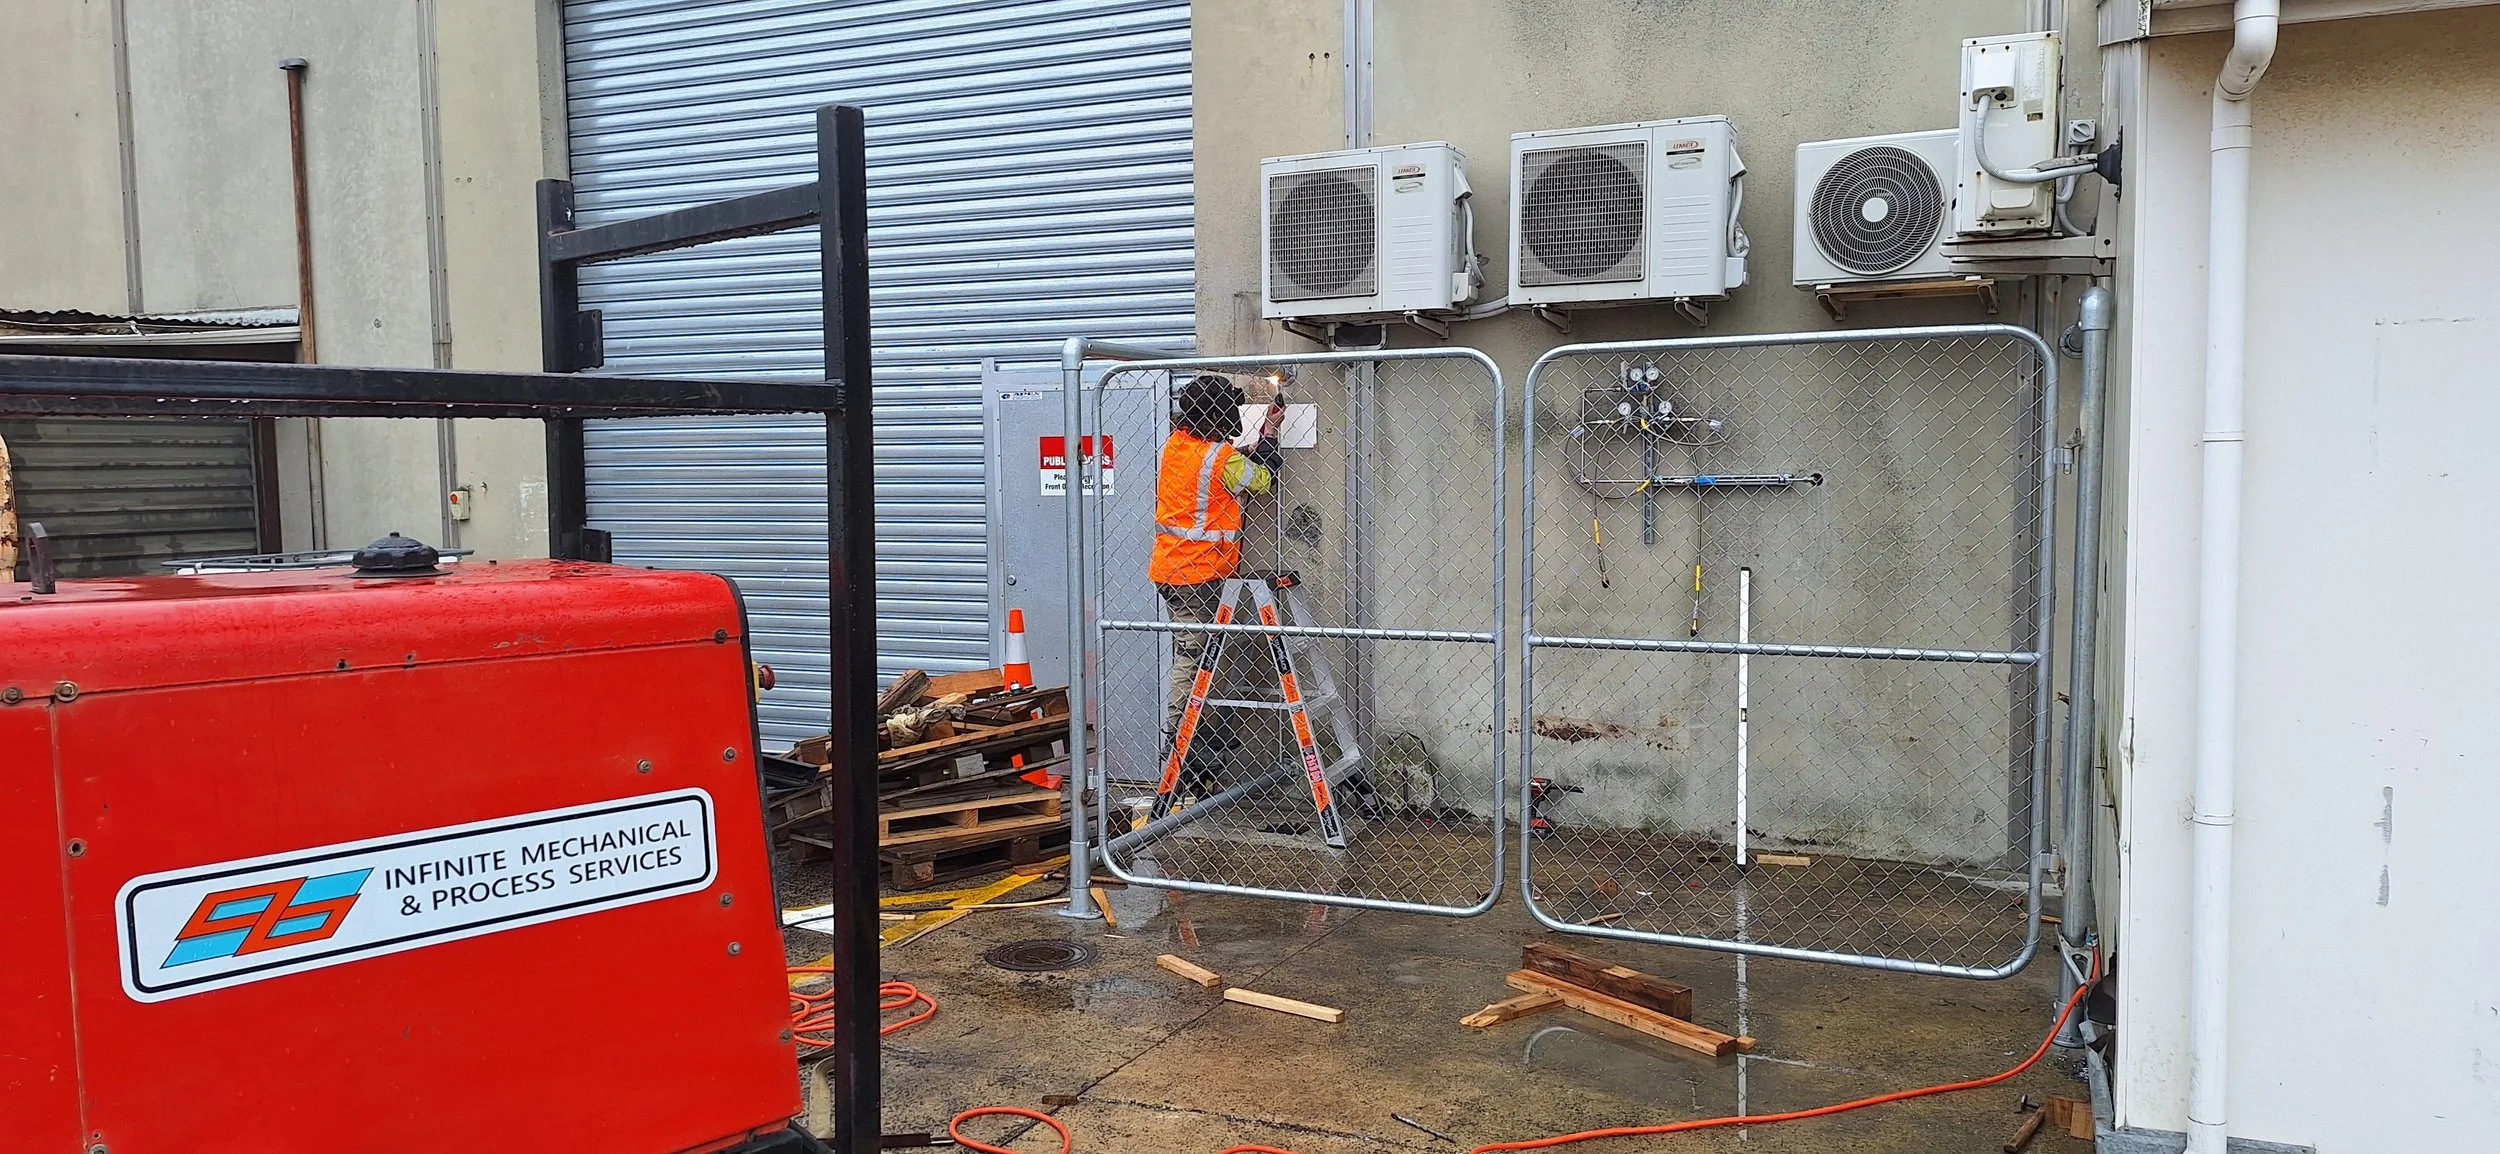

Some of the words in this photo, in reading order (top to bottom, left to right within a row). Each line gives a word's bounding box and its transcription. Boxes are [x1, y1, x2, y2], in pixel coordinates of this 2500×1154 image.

[1043, 456, 1066, 466] PUBL
[385, 850, 507, 890] INFINITE
[521, 819, 692, 866] MECHANICAL
[400, 895, 422, 916] &
[432, 869, 556, 911] PROCESS
[569, 846, 682, 884] SERVICES
